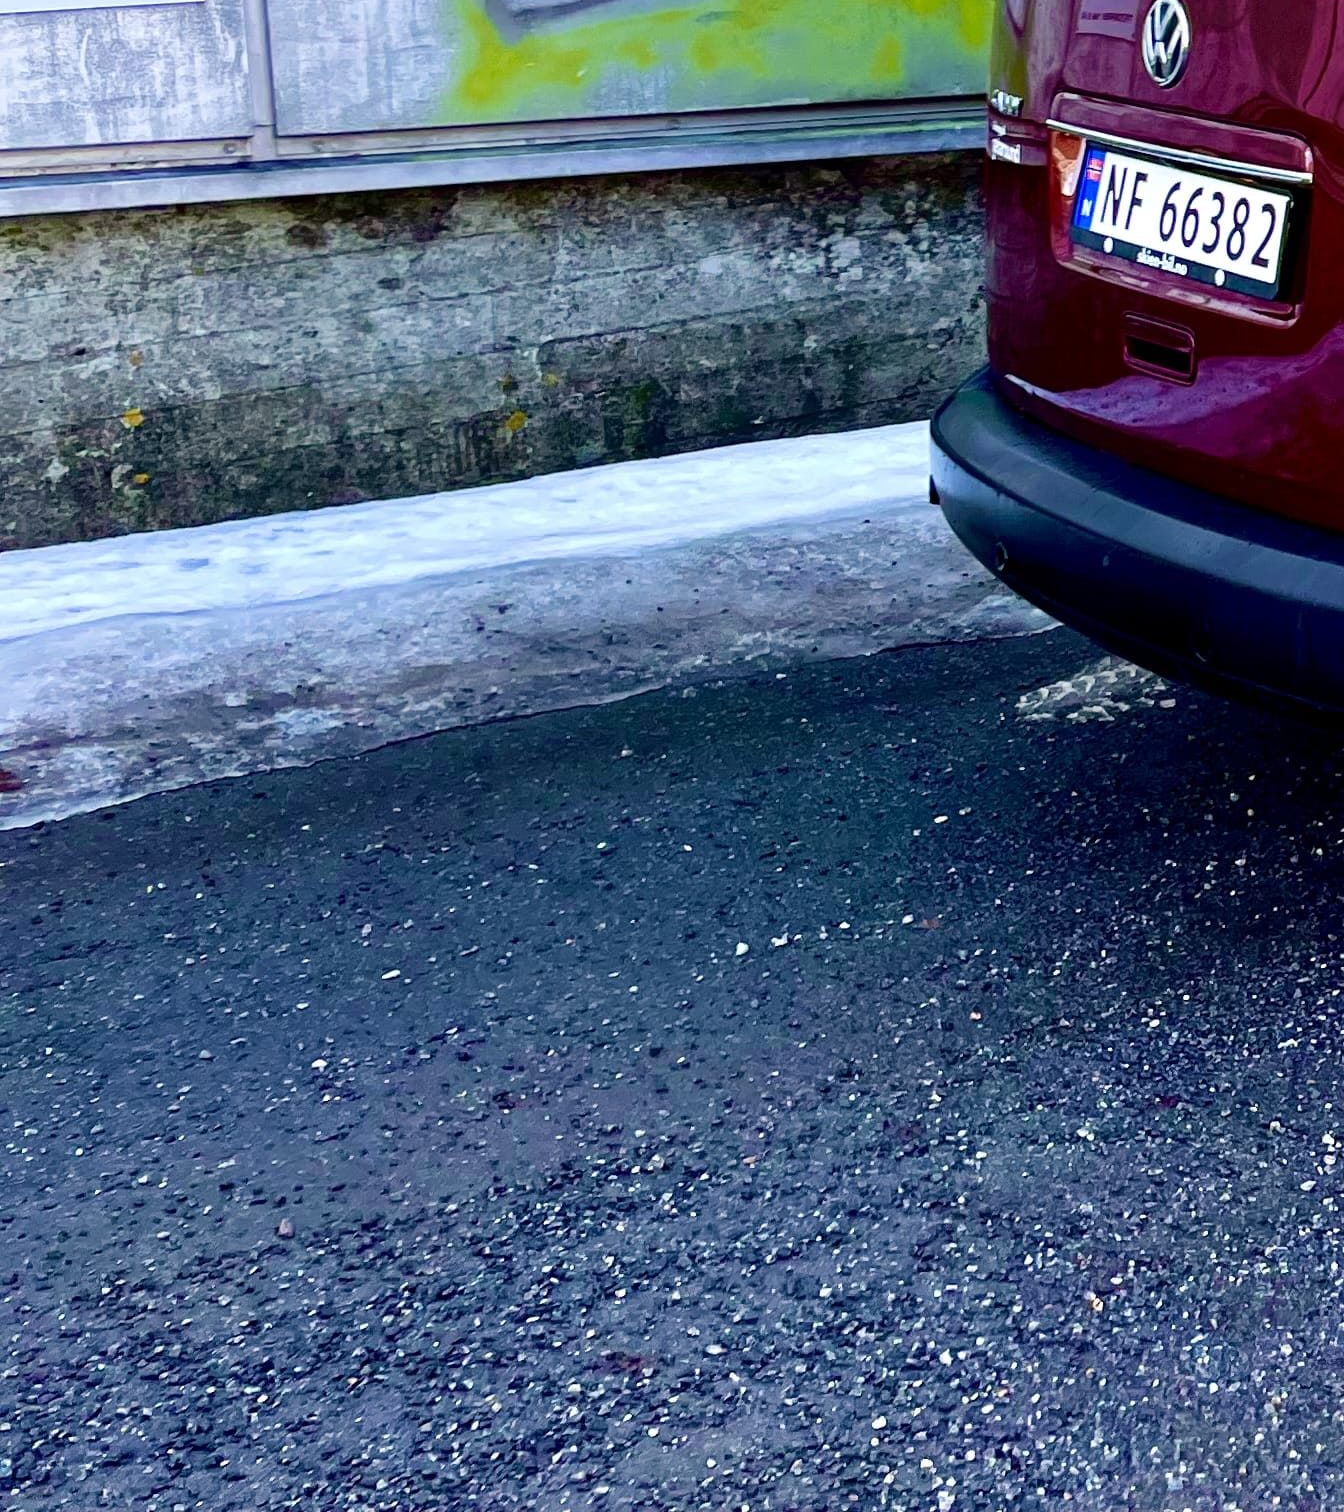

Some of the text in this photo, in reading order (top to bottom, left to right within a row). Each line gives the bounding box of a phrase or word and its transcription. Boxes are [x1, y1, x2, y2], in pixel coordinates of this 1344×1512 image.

[1080, 197, 1093, 218] N
[1101, 164, 1276, 268] NF 66382
